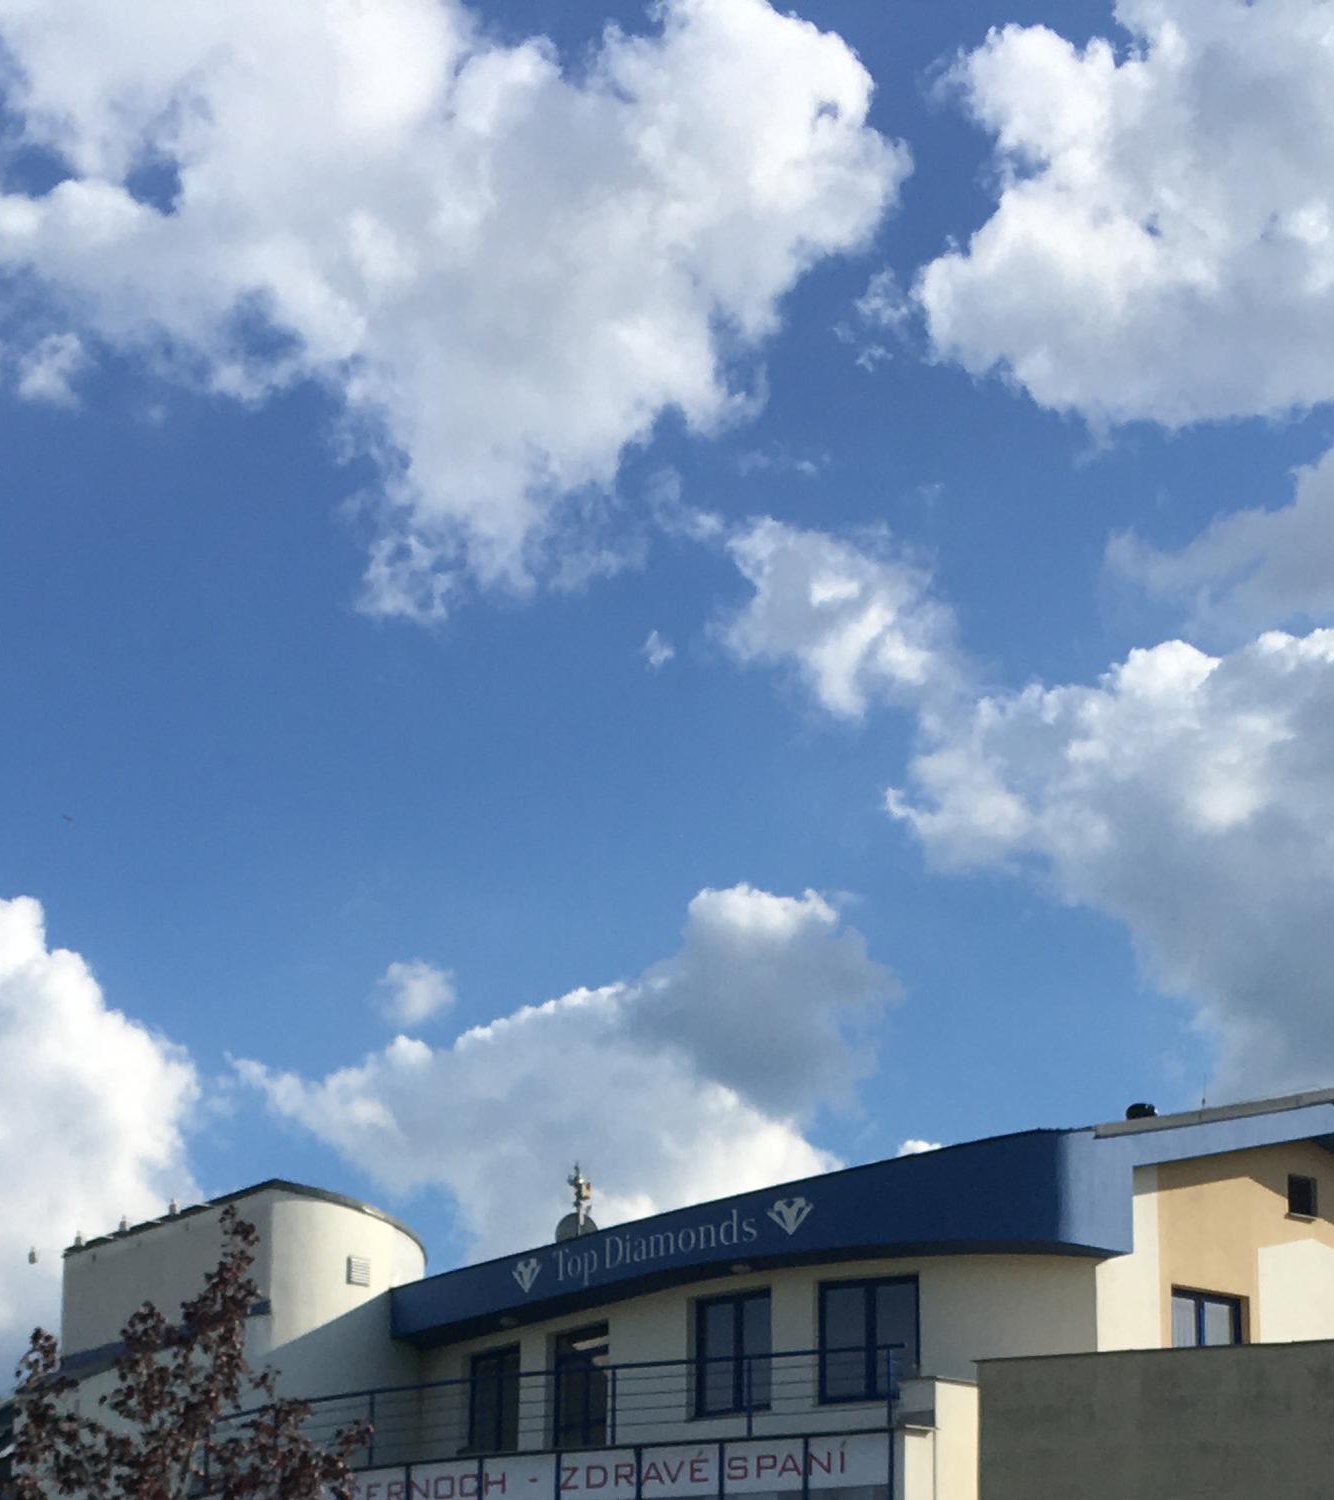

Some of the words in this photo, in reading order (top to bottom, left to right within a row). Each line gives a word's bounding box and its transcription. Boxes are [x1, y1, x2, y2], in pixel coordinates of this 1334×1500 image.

[553, 1249, 598, 1286] Top
[605, 1209, 757, 1269] Diamonds
[560, 1451, 709, 1491] ZDRAVÉ
[727, 1441, 847, 1480] SPANÍ
